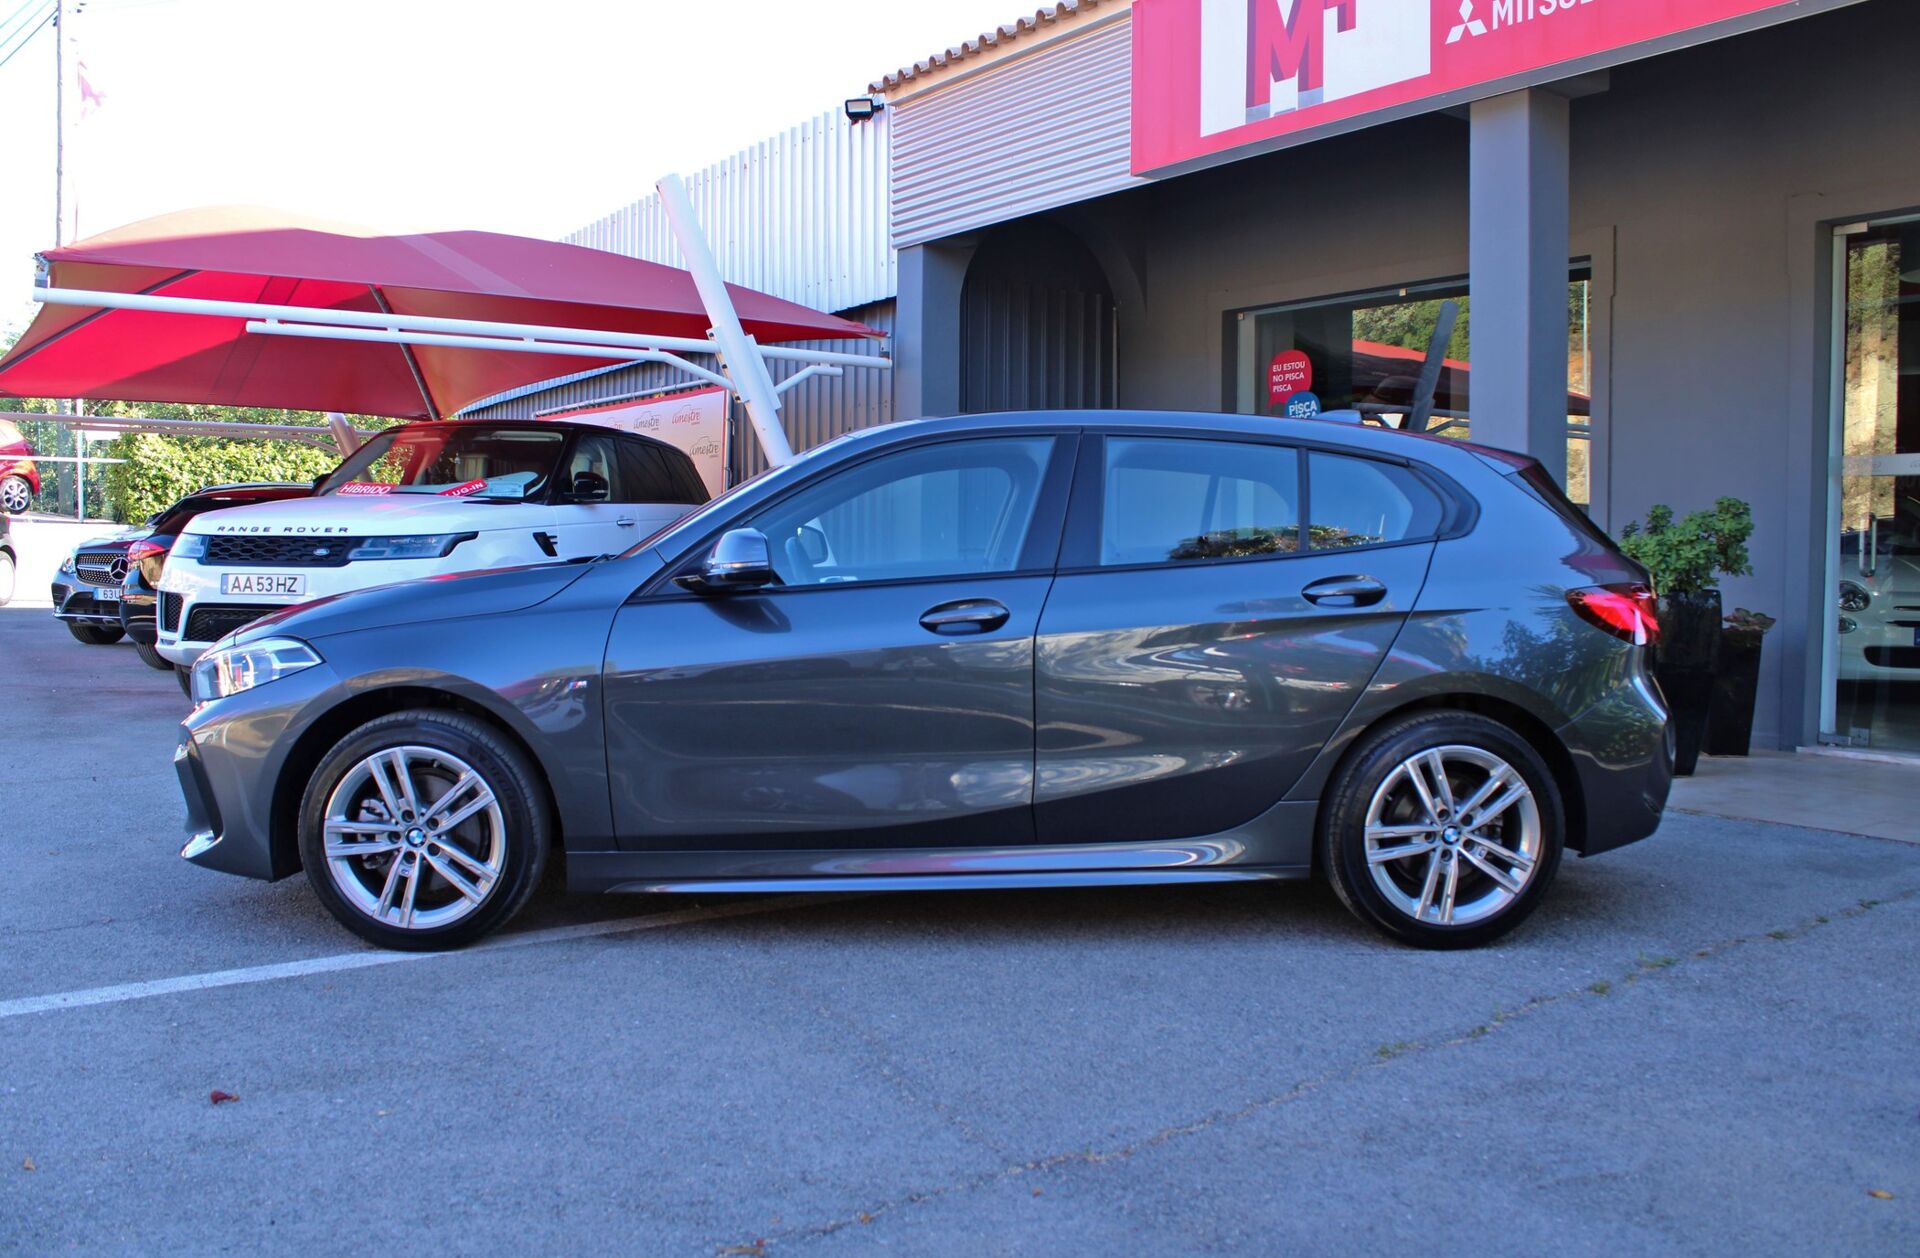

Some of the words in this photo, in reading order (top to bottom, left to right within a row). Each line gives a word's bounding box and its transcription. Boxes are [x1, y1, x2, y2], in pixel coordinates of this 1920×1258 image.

[1272, 364, 1282, 372] EU
[1283, 361, 1305, 370] ESTOU
[1273, 374, 1284, 382] NO
[1285, 372, 1304, 380] PISCA
[1273, 384, 1292, 392] PISCA
[446, 482, 484, 496] UG-IN
